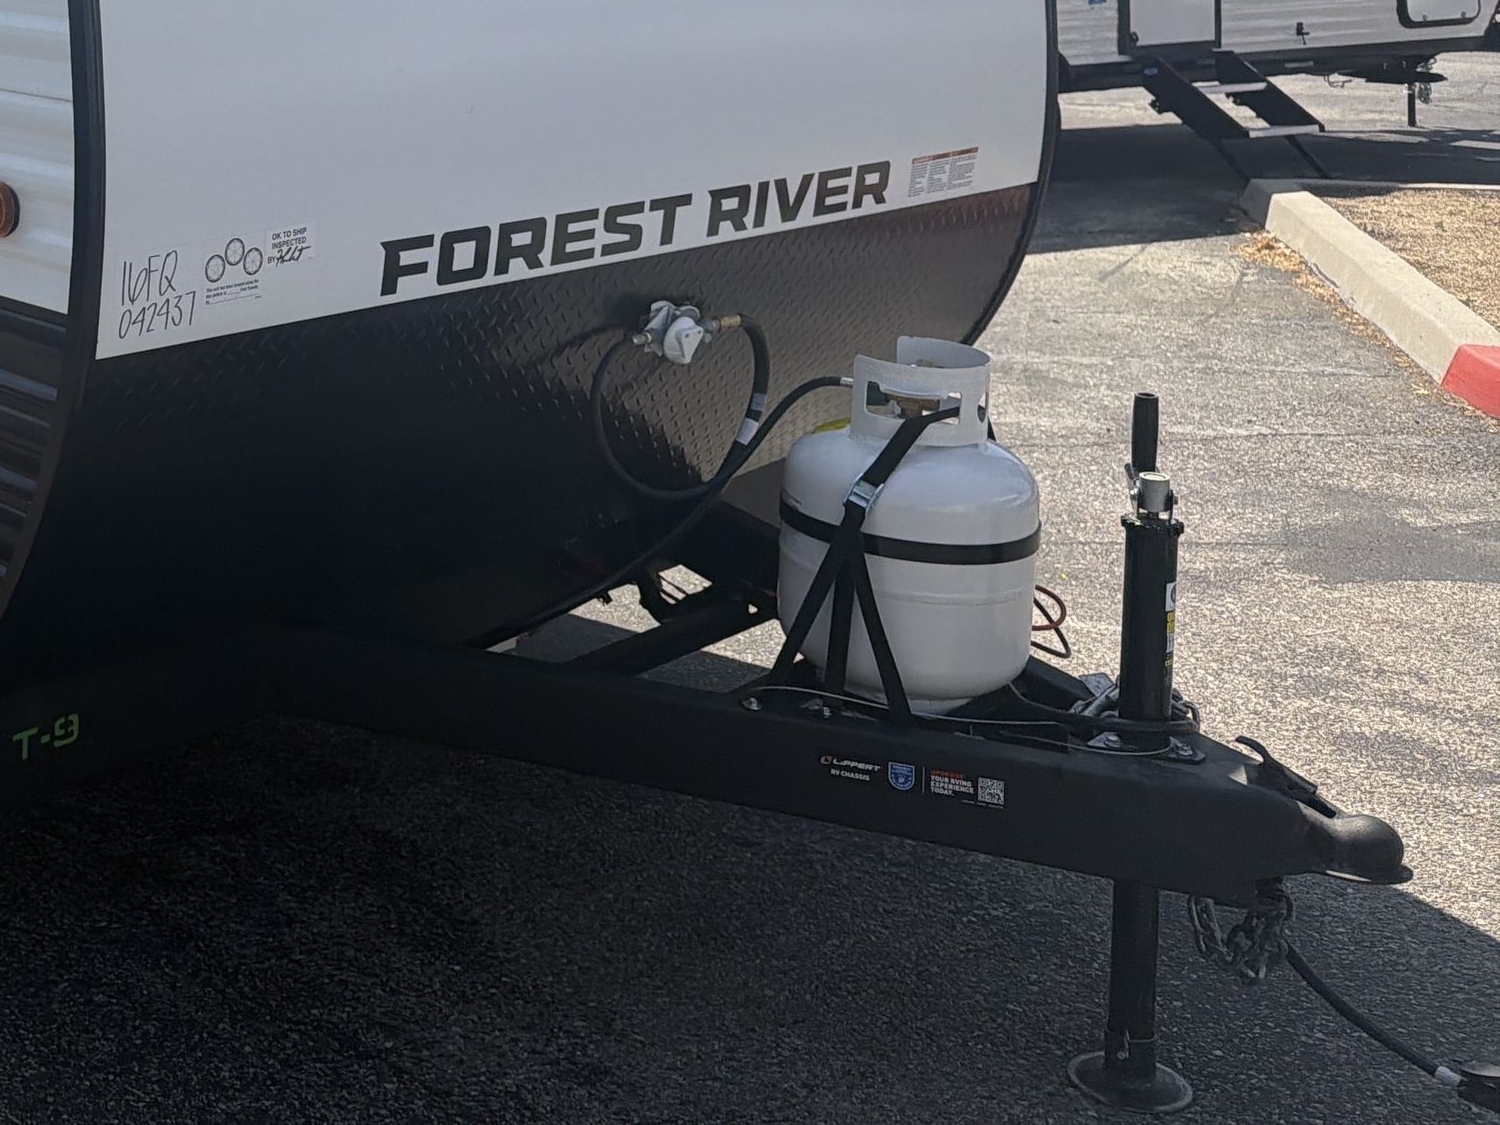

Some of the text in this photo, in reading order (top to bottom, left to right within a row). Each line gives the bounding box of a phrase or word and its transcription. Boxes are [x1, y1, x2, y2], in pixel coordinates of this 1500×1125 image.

[379, 193, 693, 297] FOREST
[706, 160, 891, 237] RIVER
[271, 236, 307, 249] INSPECTED
[931, 775, 949, 783] YOUR
[931, 781, 975, 794] EXPERIENCE
